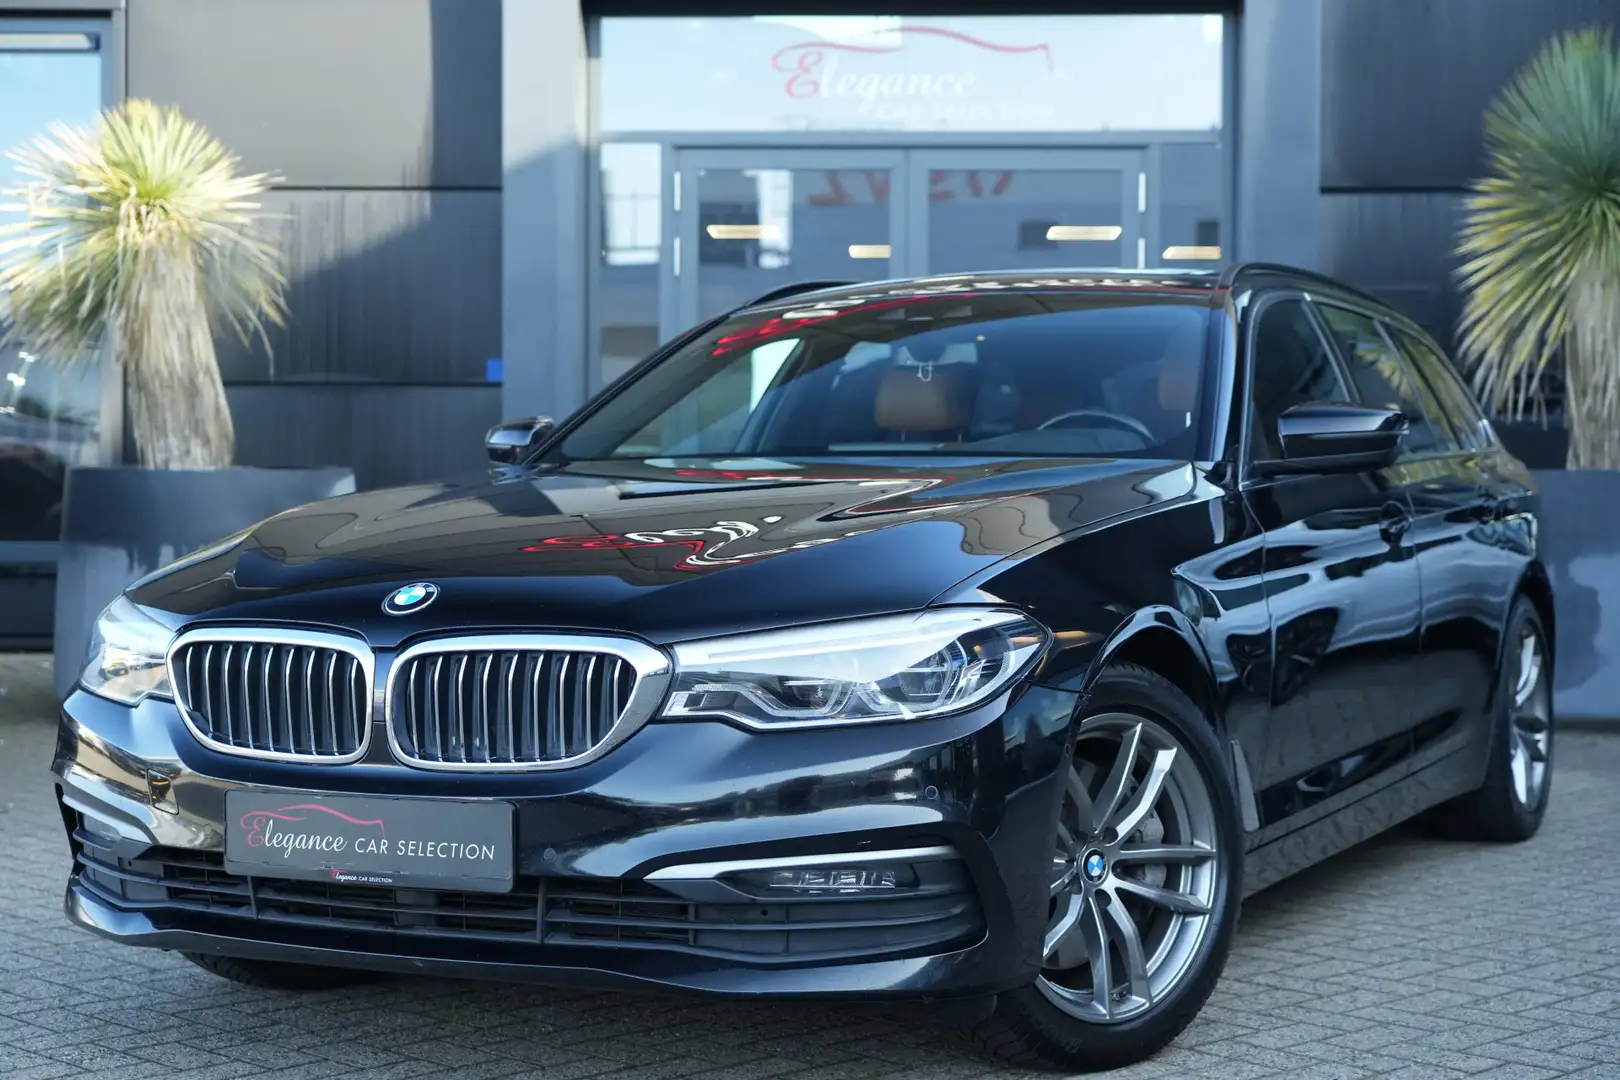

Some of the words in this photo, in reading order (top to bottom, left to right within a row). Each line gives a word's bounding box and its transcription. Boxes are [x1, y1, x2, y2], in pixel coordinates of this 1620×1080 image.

[772, 45, 976, 113] Elegance
[241, 812, 348, 858] Elegance
[354, 838, 389, 854] CAR
[397, 840, 495, 860] SELECTION
